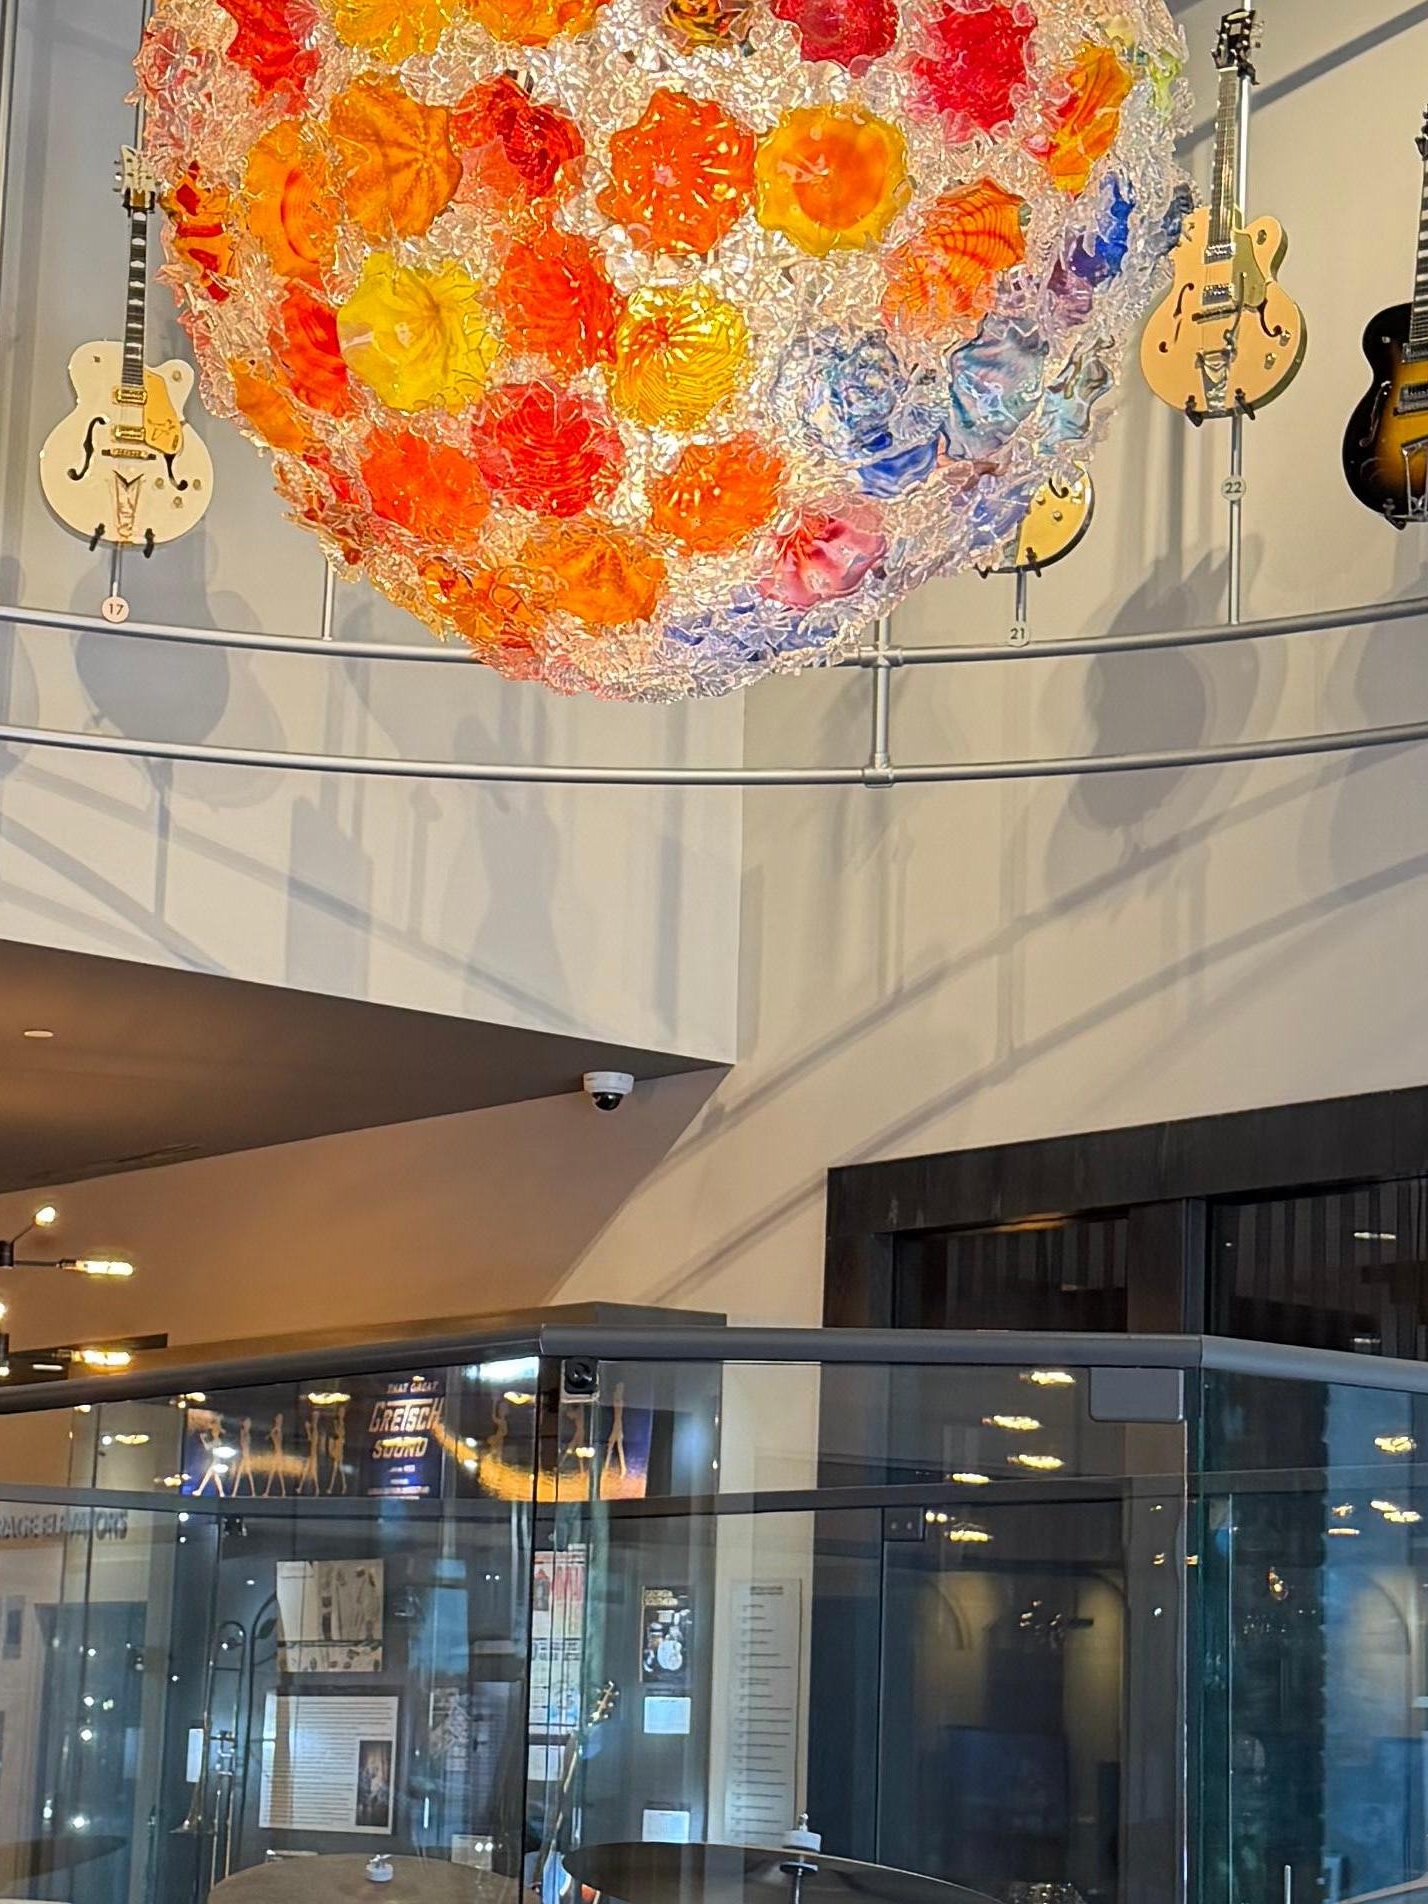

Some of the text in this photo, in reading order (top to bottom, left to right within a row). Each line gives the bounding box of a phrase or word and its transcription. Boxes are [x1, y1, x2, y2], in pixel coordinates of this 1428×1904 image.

[1224, 481, 1242, 494] 22
[108, 603, 125, 615] 17
[1009, 627, 1025, 640] 21
[368, 1397, 445, 1433] GRETSCH
